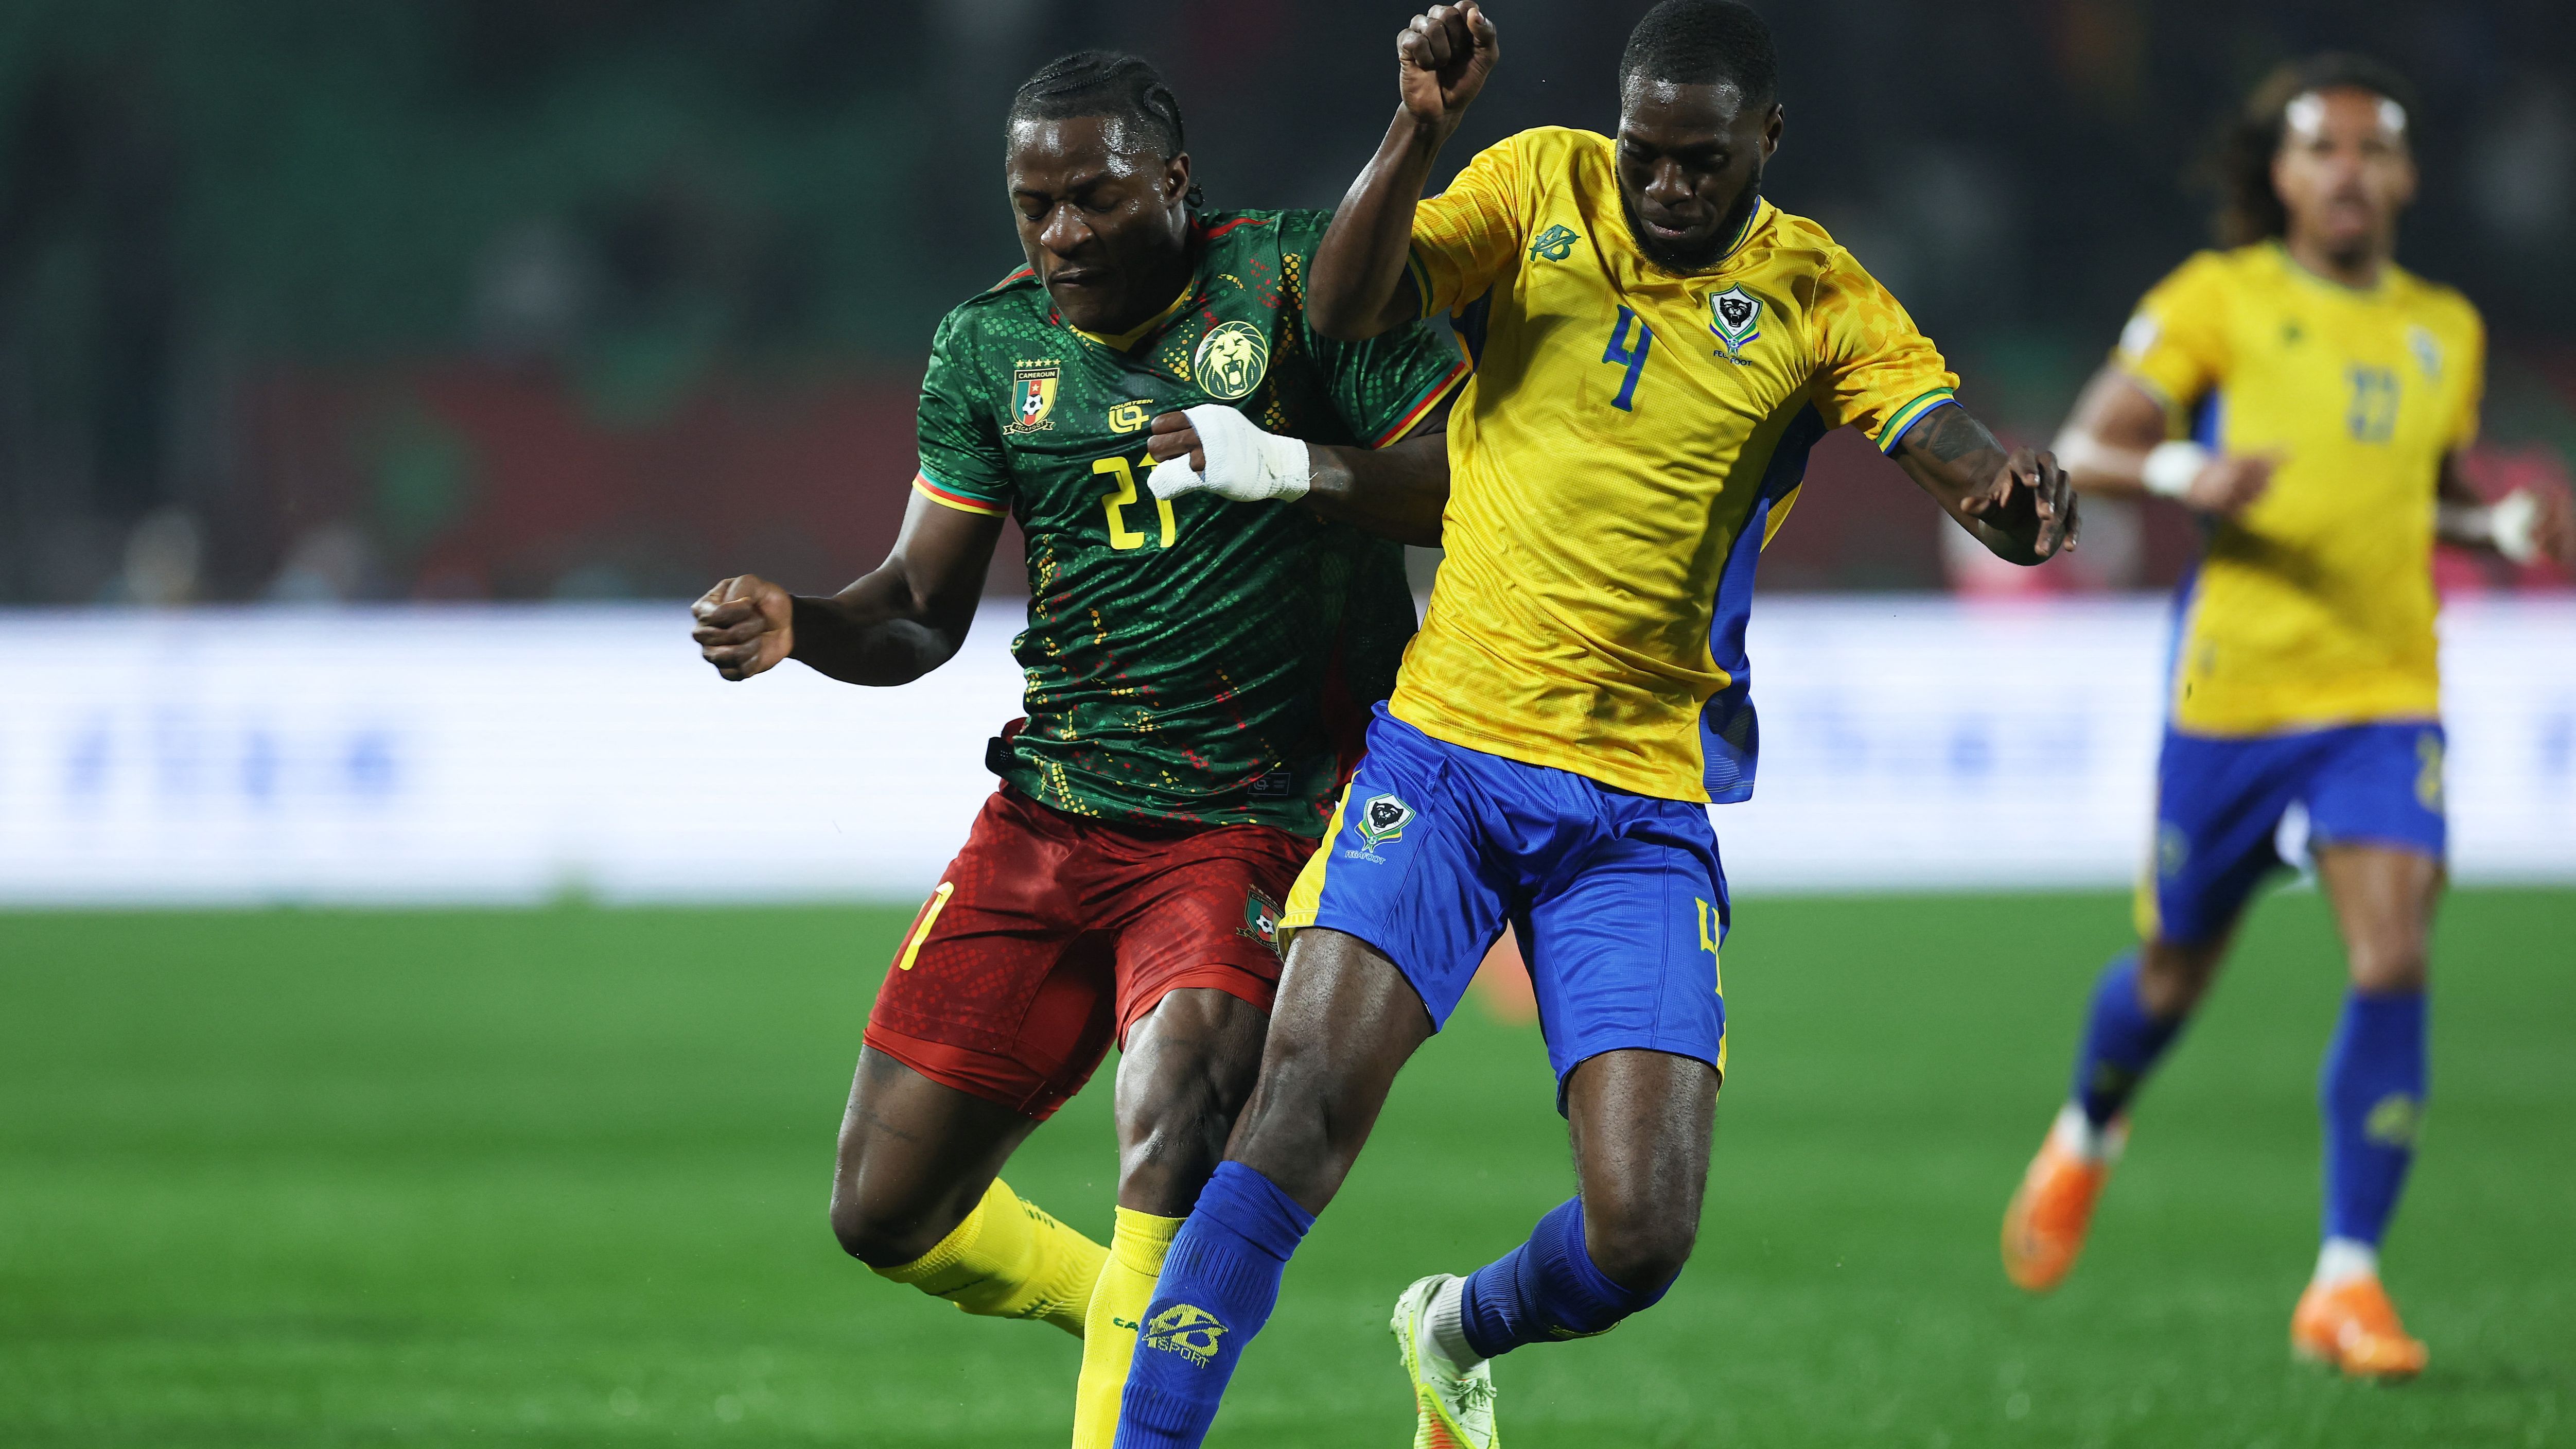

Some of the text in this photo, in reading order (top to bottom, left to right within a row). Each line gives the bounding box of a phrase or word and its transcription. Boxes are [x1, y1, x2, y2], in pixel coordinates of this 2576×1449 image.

[1602, 304, 1652, 412] 4
[1110, 399, 1153, 411] FOURTEEN
[1015, 422, 1044, 431] FECAFOOT
[1092, 452, 1176, 550] 21
[1345, 850, 1386, 865] FEGAFOOT
[1695, 896, 1723, 999] 4
[1158, 1337, 1210, 1369] SPORT
